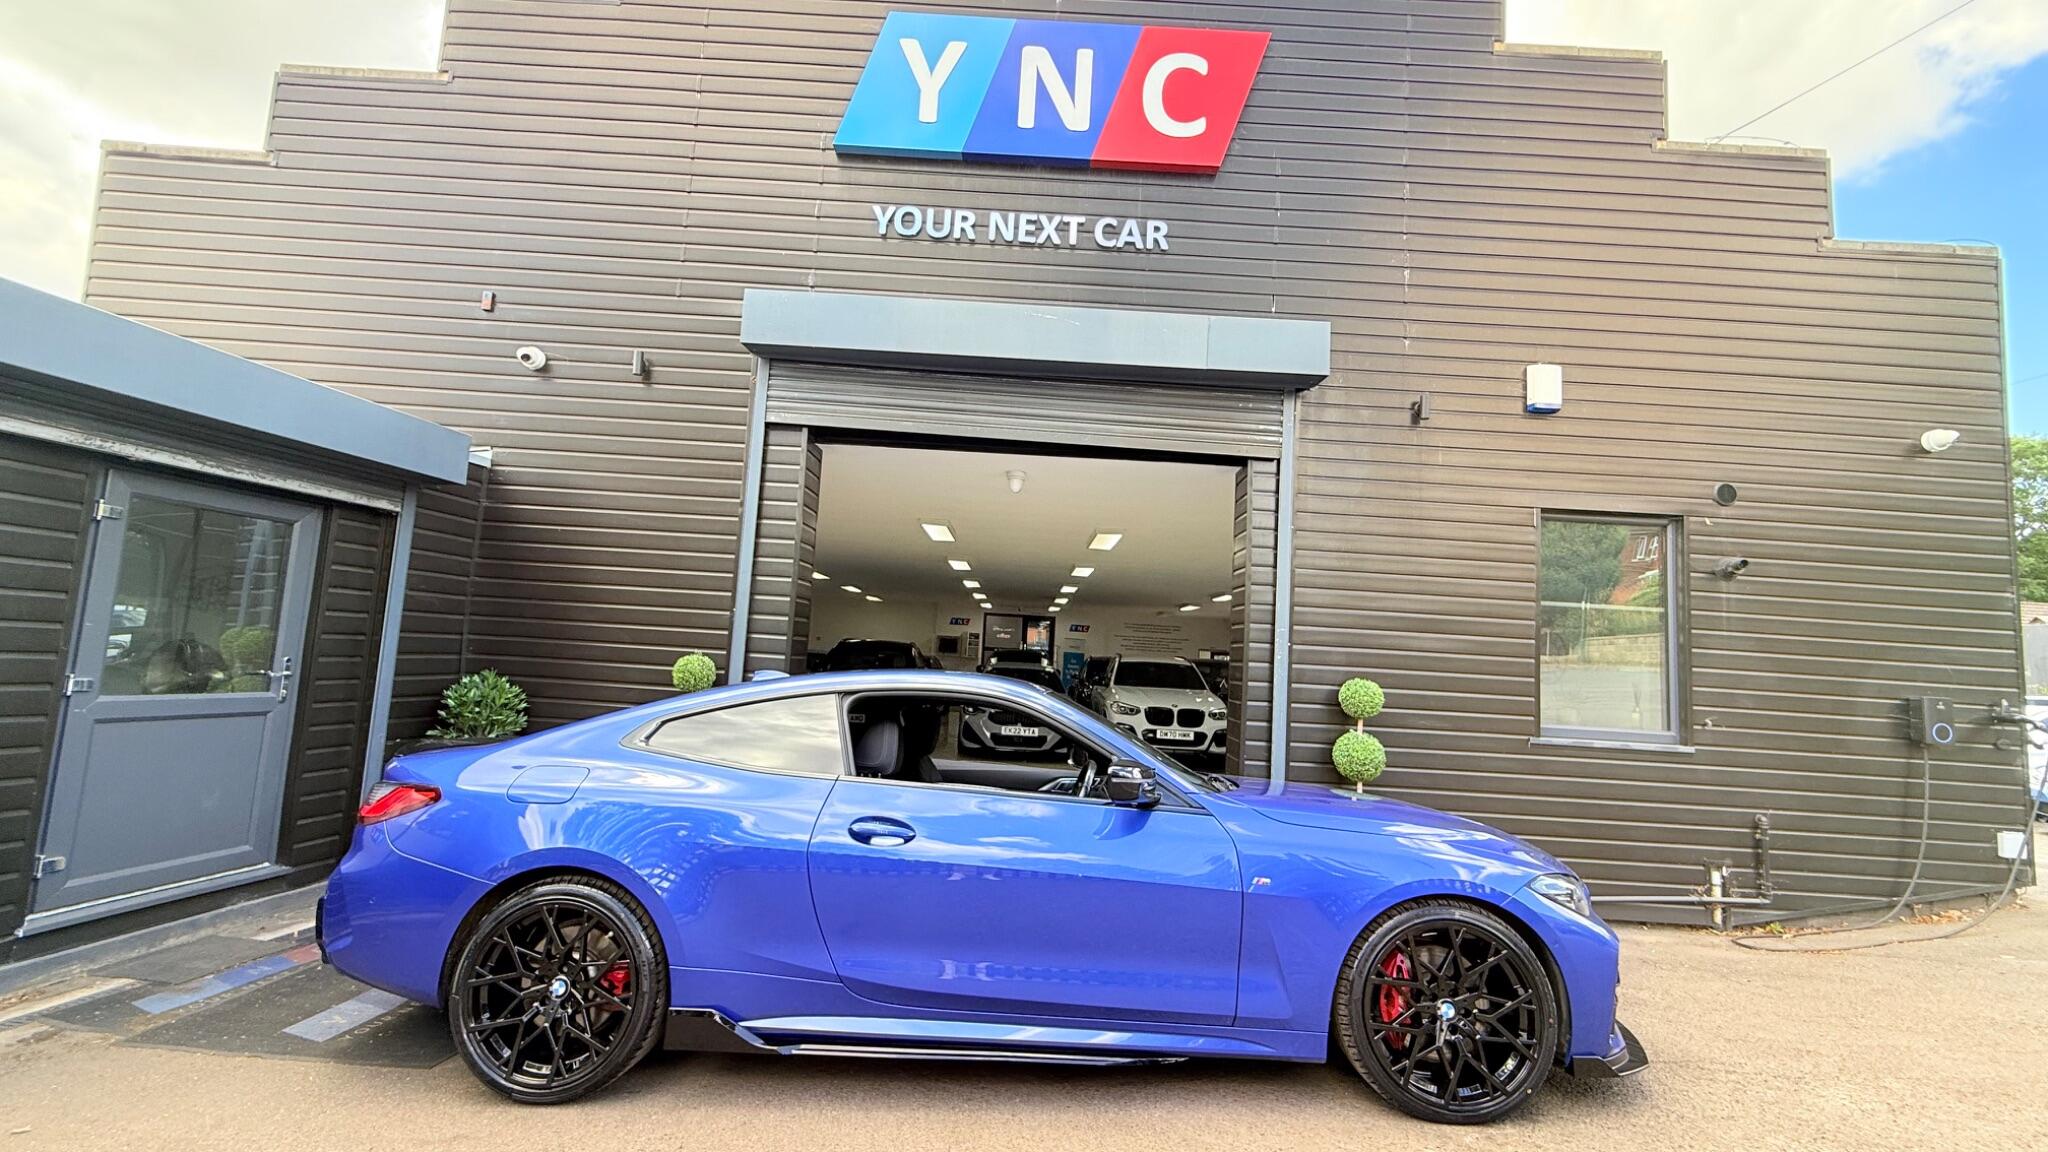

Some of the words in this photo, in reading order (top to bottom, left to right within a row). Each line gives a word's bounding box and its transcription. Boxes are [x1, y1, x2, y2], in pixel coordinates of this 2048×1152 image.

[899, 37, 1209, 138] YNC
[872, 204, 977, 242] YOUR
[987, 211, 1086, 247] NEXT
[1093, 216, 1169, 252] CAR
